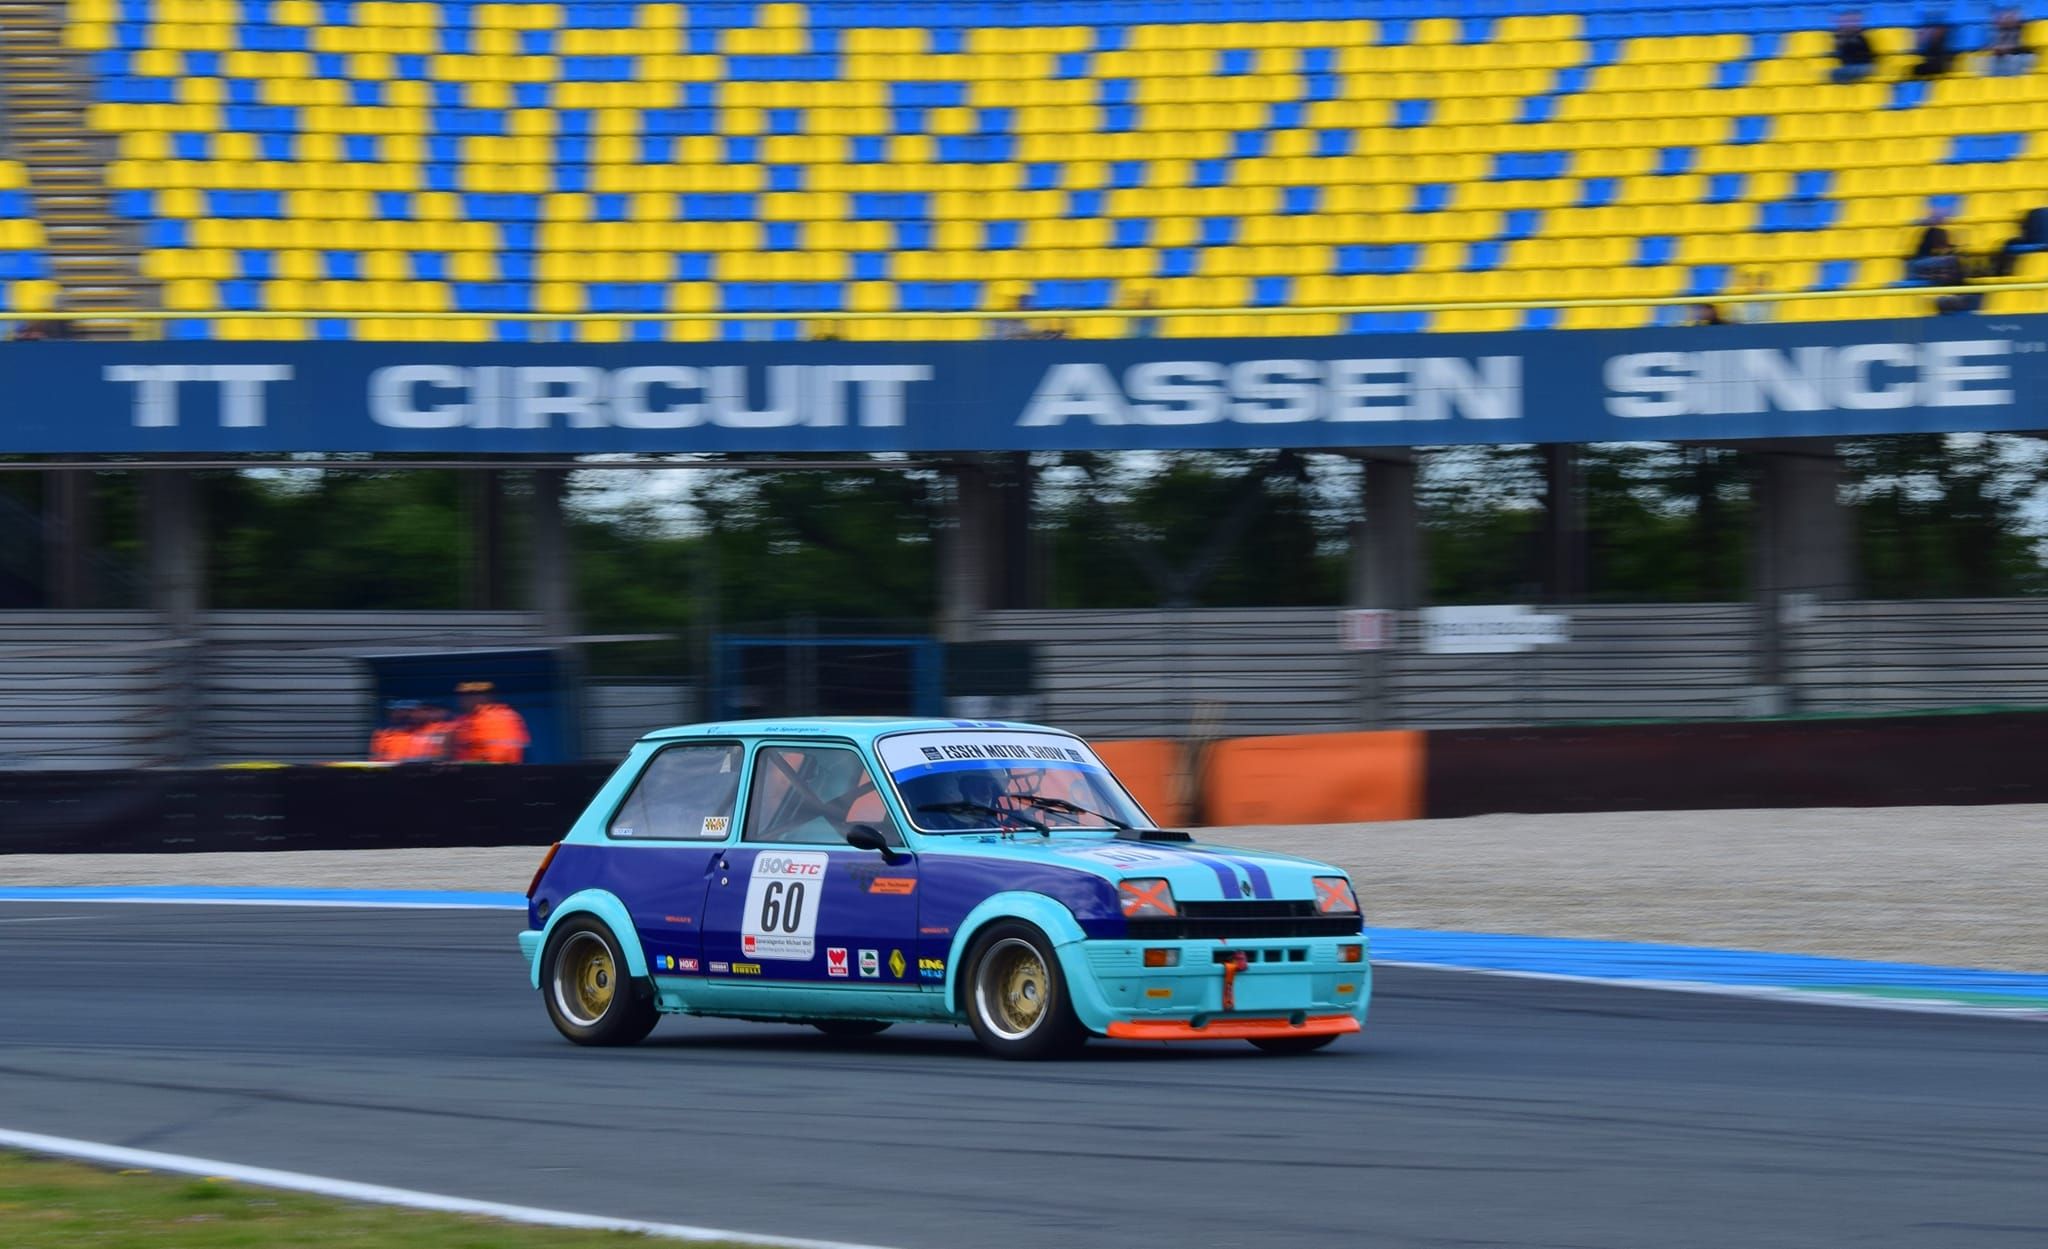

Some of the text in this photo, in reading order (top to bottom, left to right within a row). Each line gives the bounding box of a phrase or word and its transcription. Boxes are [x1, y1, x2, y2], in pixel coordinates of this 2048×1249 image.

[102, 340, 2016, 429] TT CIRCUIT ASSEN SINCE
[941, 745, 986, 759] ESSEN
[981, 744, 1031, 759] MOTOR
[1027, 745, 1068, 760] SHOW
[760, 881, 805, 934] 60
